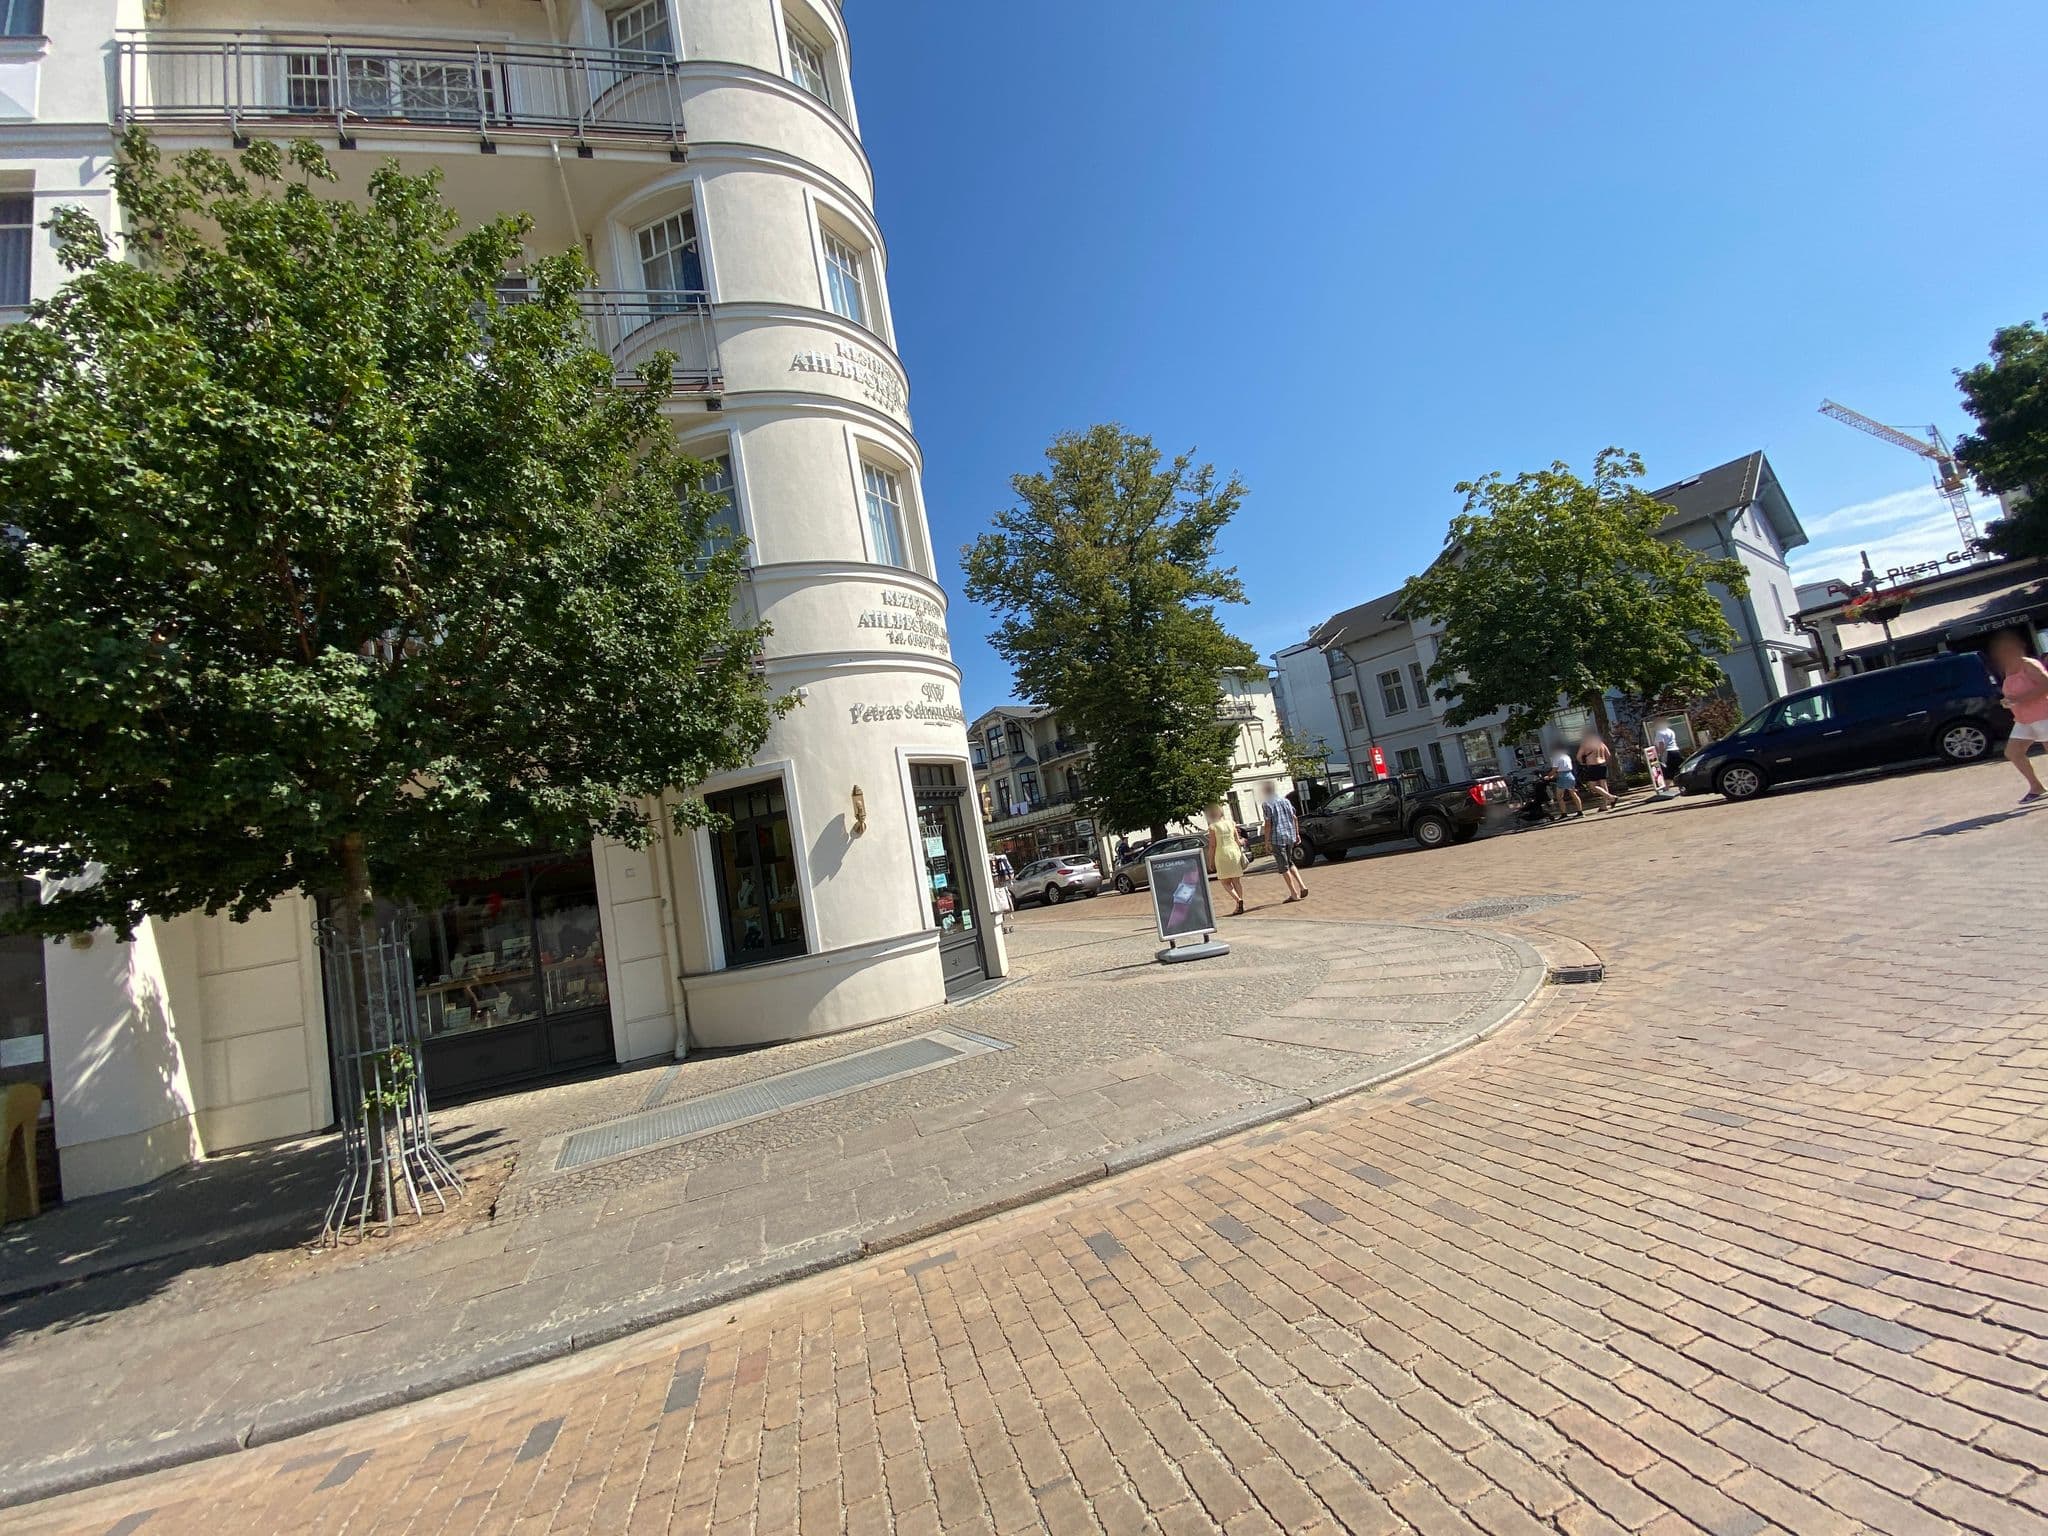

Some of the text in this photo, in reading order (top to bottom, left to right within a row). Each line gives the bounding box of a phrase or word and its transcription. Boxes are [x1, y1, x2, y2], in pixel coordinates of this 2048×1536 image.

[1945, 548, 1978, 565] Gel
[881, 589, 942, 620] REZEPTION
[848, 702, 904, 725] Petras
